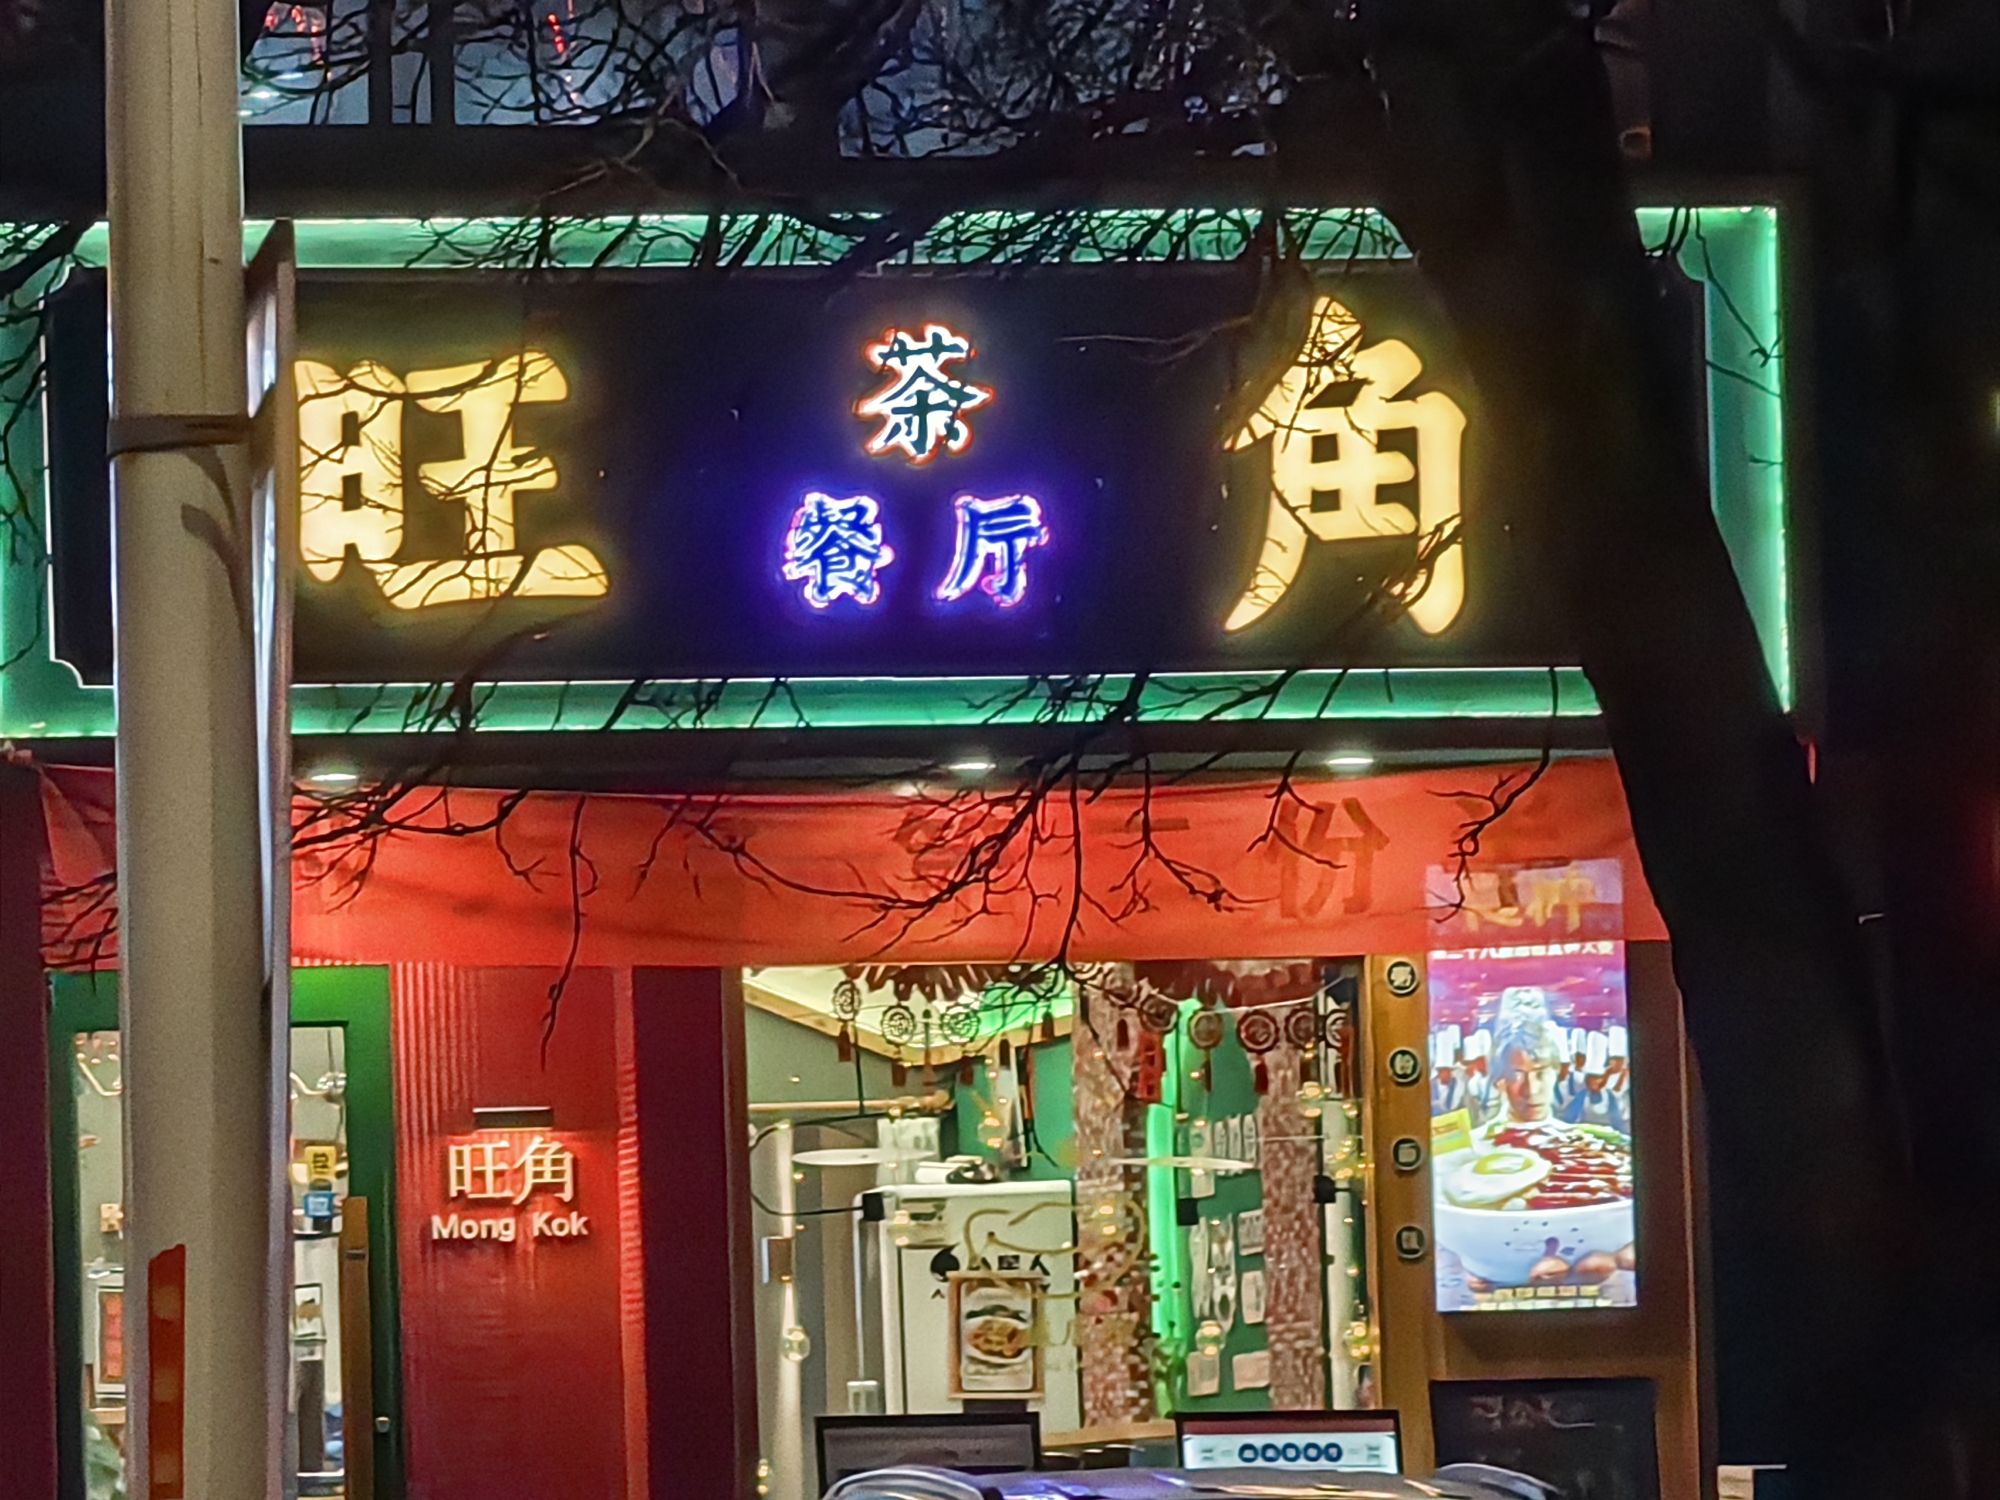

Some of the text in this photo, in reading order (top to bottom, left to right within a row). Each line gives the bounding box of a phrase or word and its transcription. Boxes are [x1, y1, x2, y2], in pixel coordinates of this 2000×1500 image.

[855, 320, 994, 464] 茶
[293, 351, 609, 609] 旺
[1224, 296, 1468, 637] 角
[783, 491, 1048, 608] 餐厅
[431, 1211, 589, 1242] Mong Kok
[448, 1135, 575, 1205] 旺角
